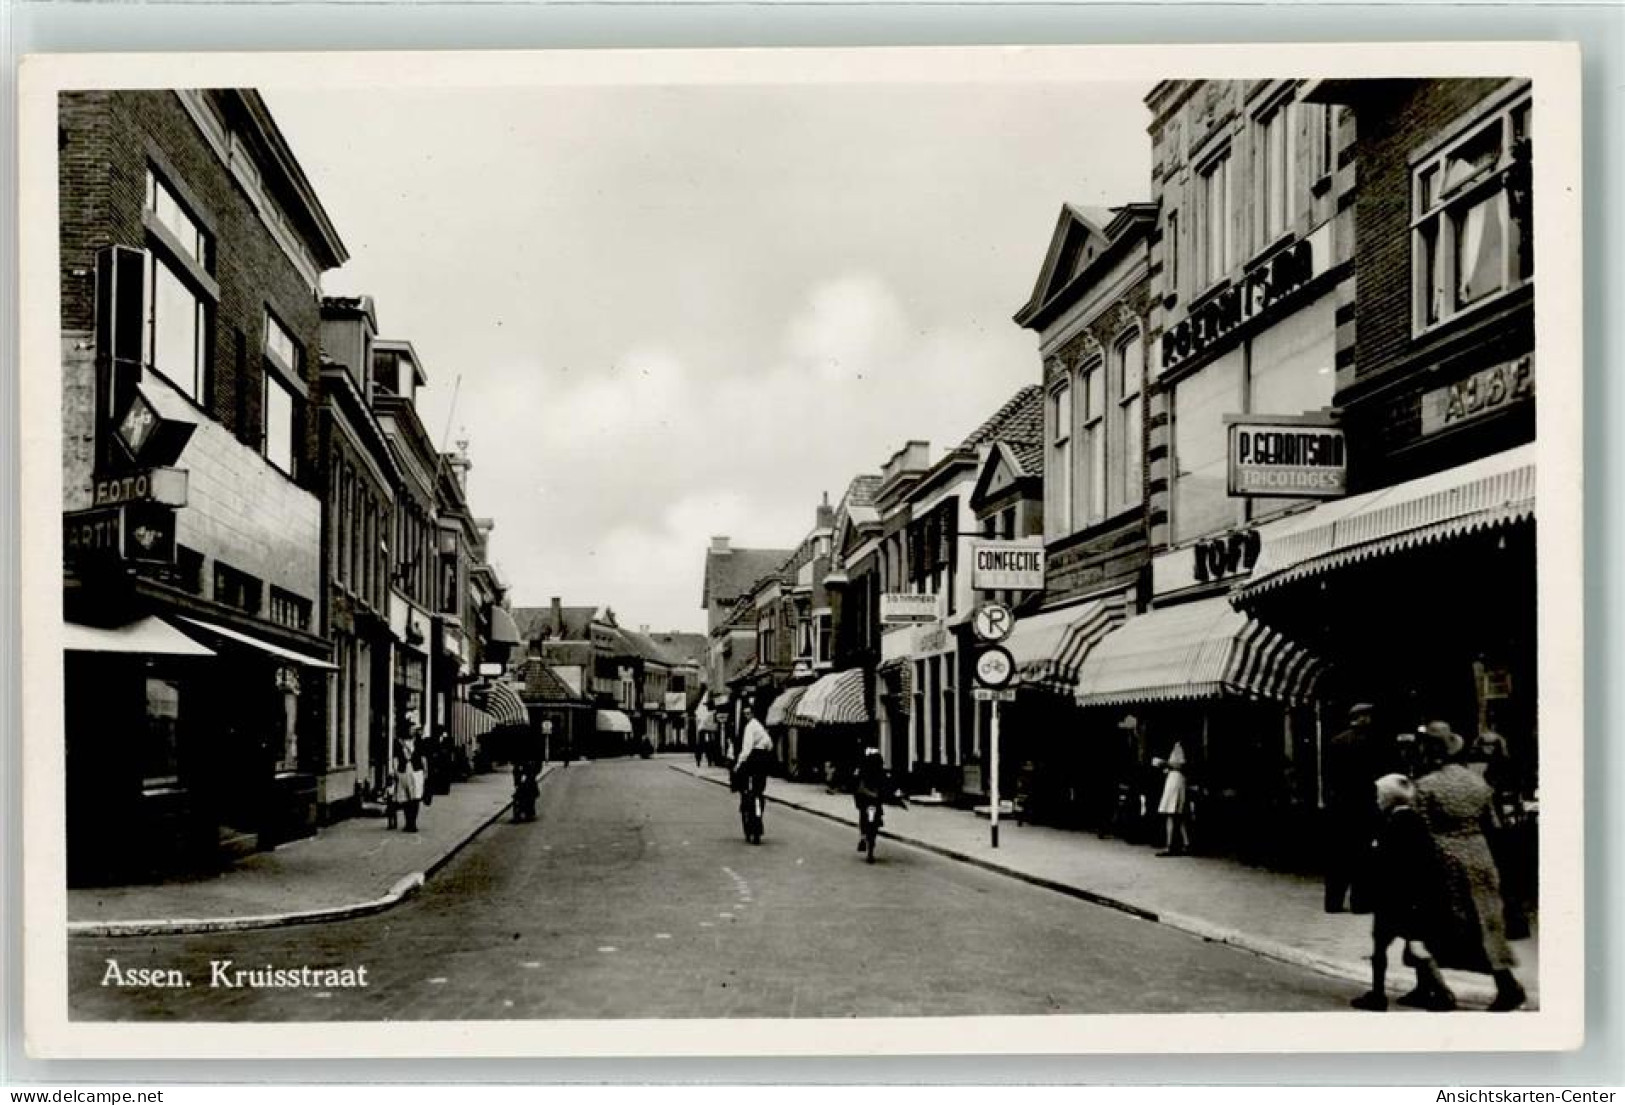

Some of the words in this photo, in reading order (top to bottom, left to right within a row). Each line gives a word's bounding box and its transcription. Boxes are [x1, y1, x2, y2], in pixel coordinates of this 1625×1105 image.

[1243, 470, 1339, 487] TRICOTAGES
[98, 475, 147, 503] FOTO
[978, 551, 1040, 571] CONFECTIE
